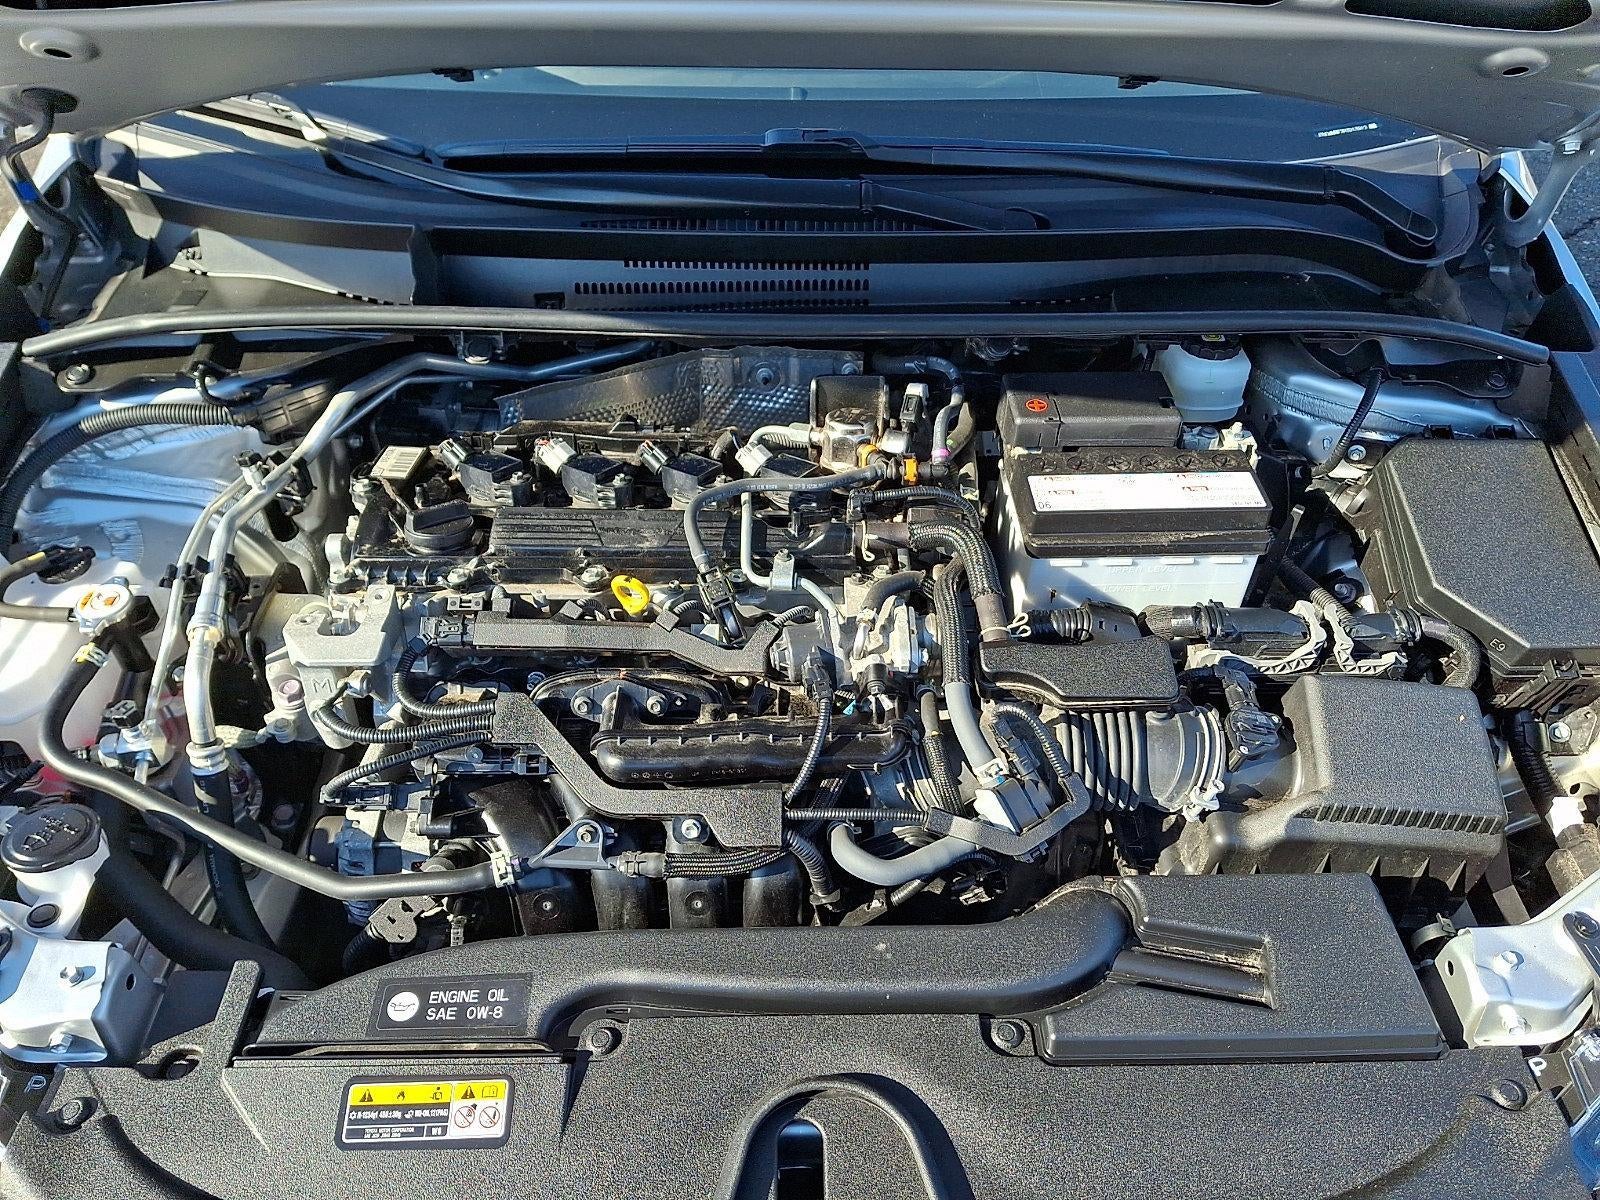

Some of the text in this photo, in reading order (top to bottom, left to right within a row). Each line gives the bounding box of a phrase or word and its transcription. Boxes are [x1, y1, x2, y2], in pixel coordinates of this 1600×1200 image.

[1489, 638, 1506, 652] E9
[428, 988, 510, 1004] ENGINE OIL
[425, 1005, 503, 1021] SAE 0W-8
[1527, 1057, 1548, 1077] P
